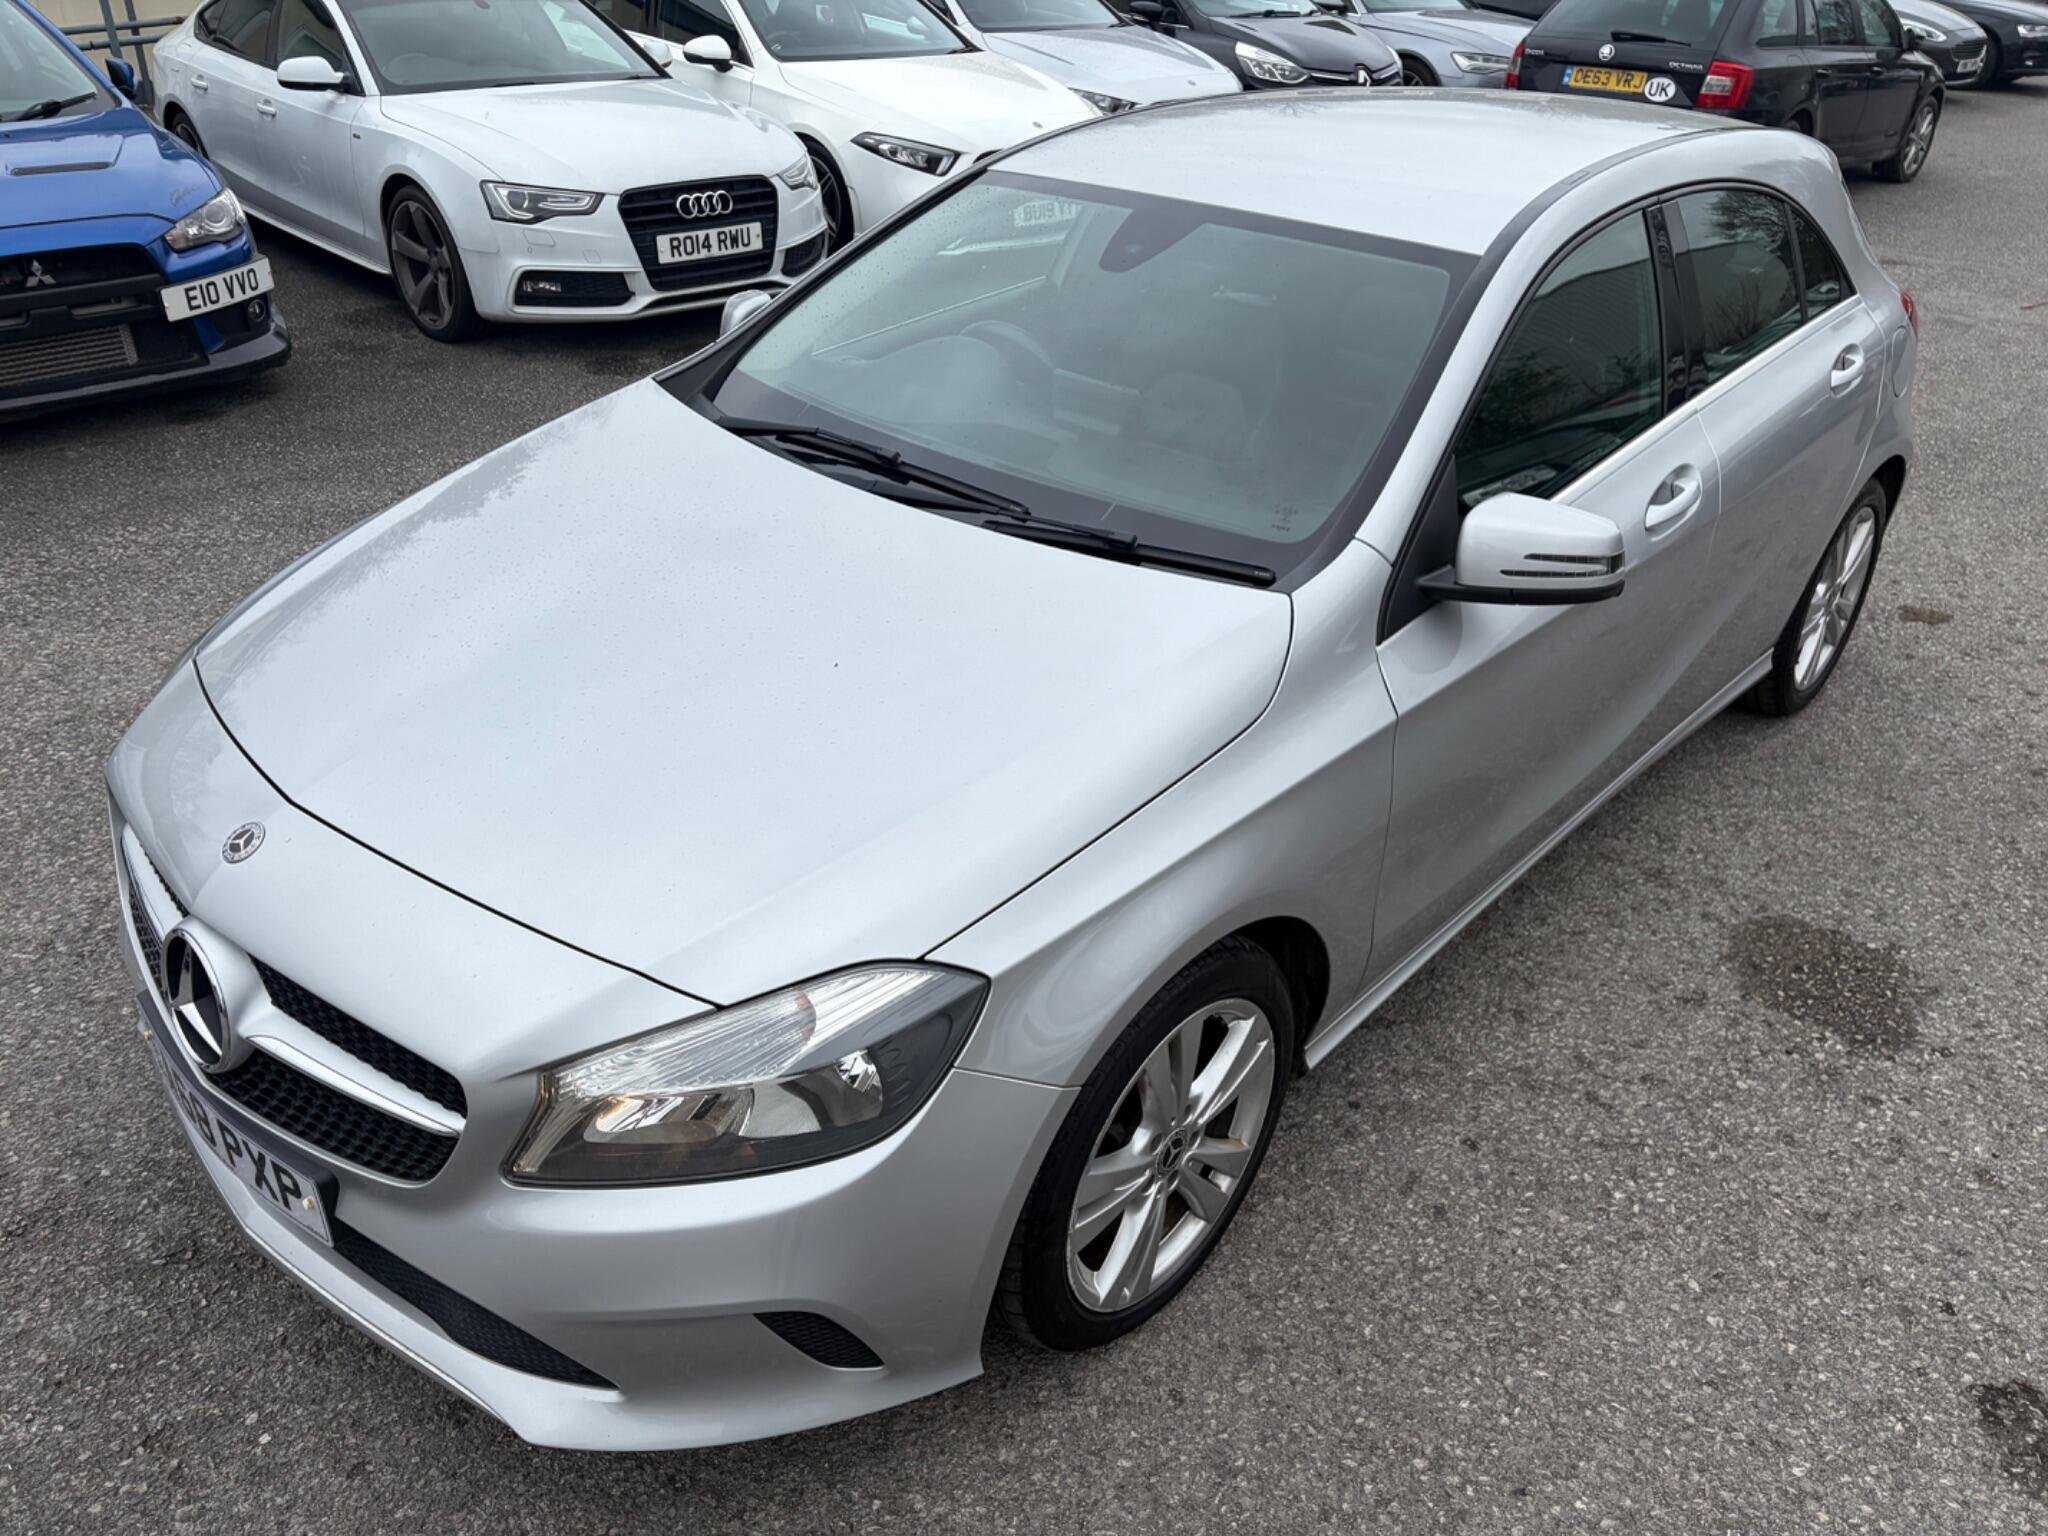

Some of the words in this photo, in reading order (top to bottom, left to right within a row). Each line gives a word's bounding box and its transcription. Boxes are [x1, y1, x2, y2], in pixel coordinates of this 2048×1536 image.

[1615, 70, 1645, 89] VRJ
[1648, 80, 1671, 98] UK
[669, 233, 712, 258] RO14
[717, 227, 751, 252] RWU
[184, 280, 221, 311] E10
[222, 267, 259, 299] VVO
[217, 1119, 302, 1211] PXP
